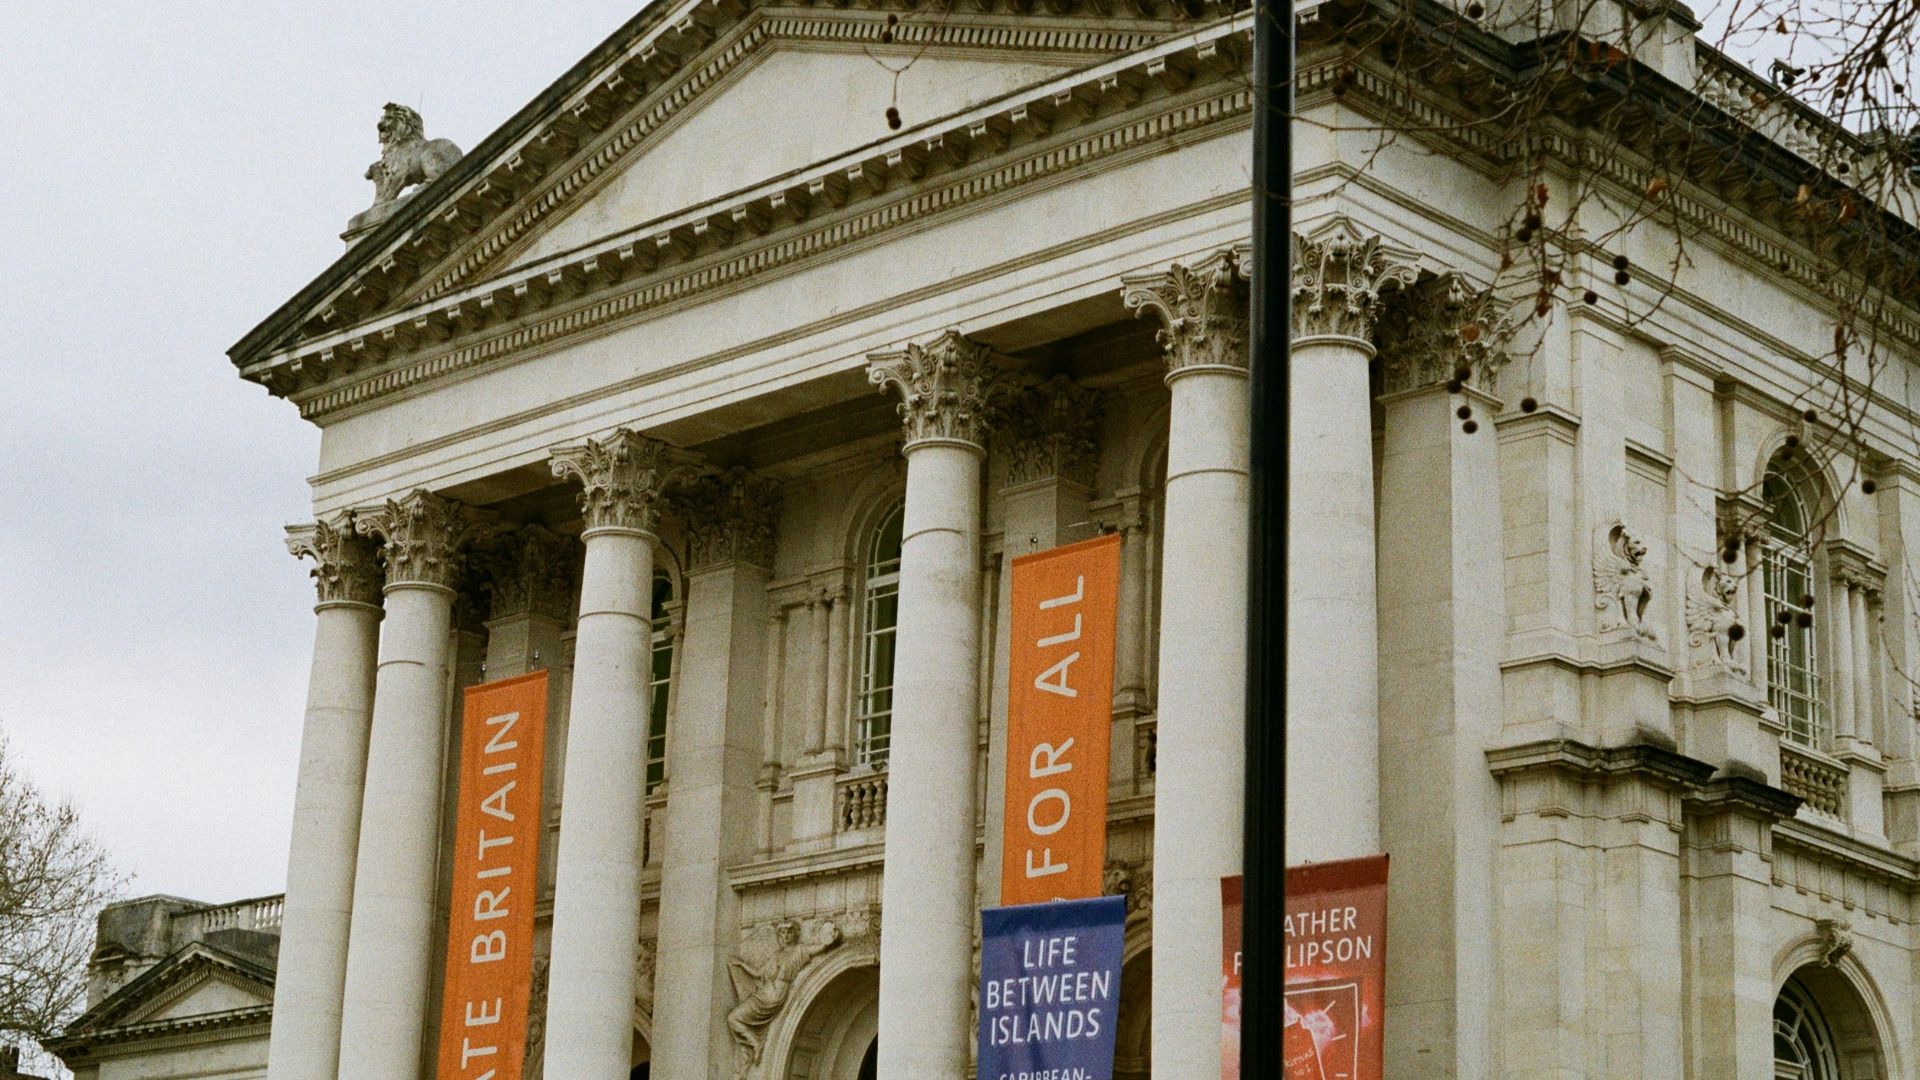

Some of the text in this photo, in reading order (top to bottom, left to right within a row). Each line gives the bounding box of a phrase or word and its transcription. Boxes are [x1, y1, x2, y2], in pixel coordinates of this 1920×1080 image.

[1026, 575, 1084, 879] FOR ALL
[461, 711, 520, 1080] TE BRITAIN
[1284, 906, 1358, 938] ATHER
[1023, 936, 1077, 969] LIFE
[986, 969, 1110, 1010] BETWEEN
[990, 1008, 1100, 1046] ISLANDS
